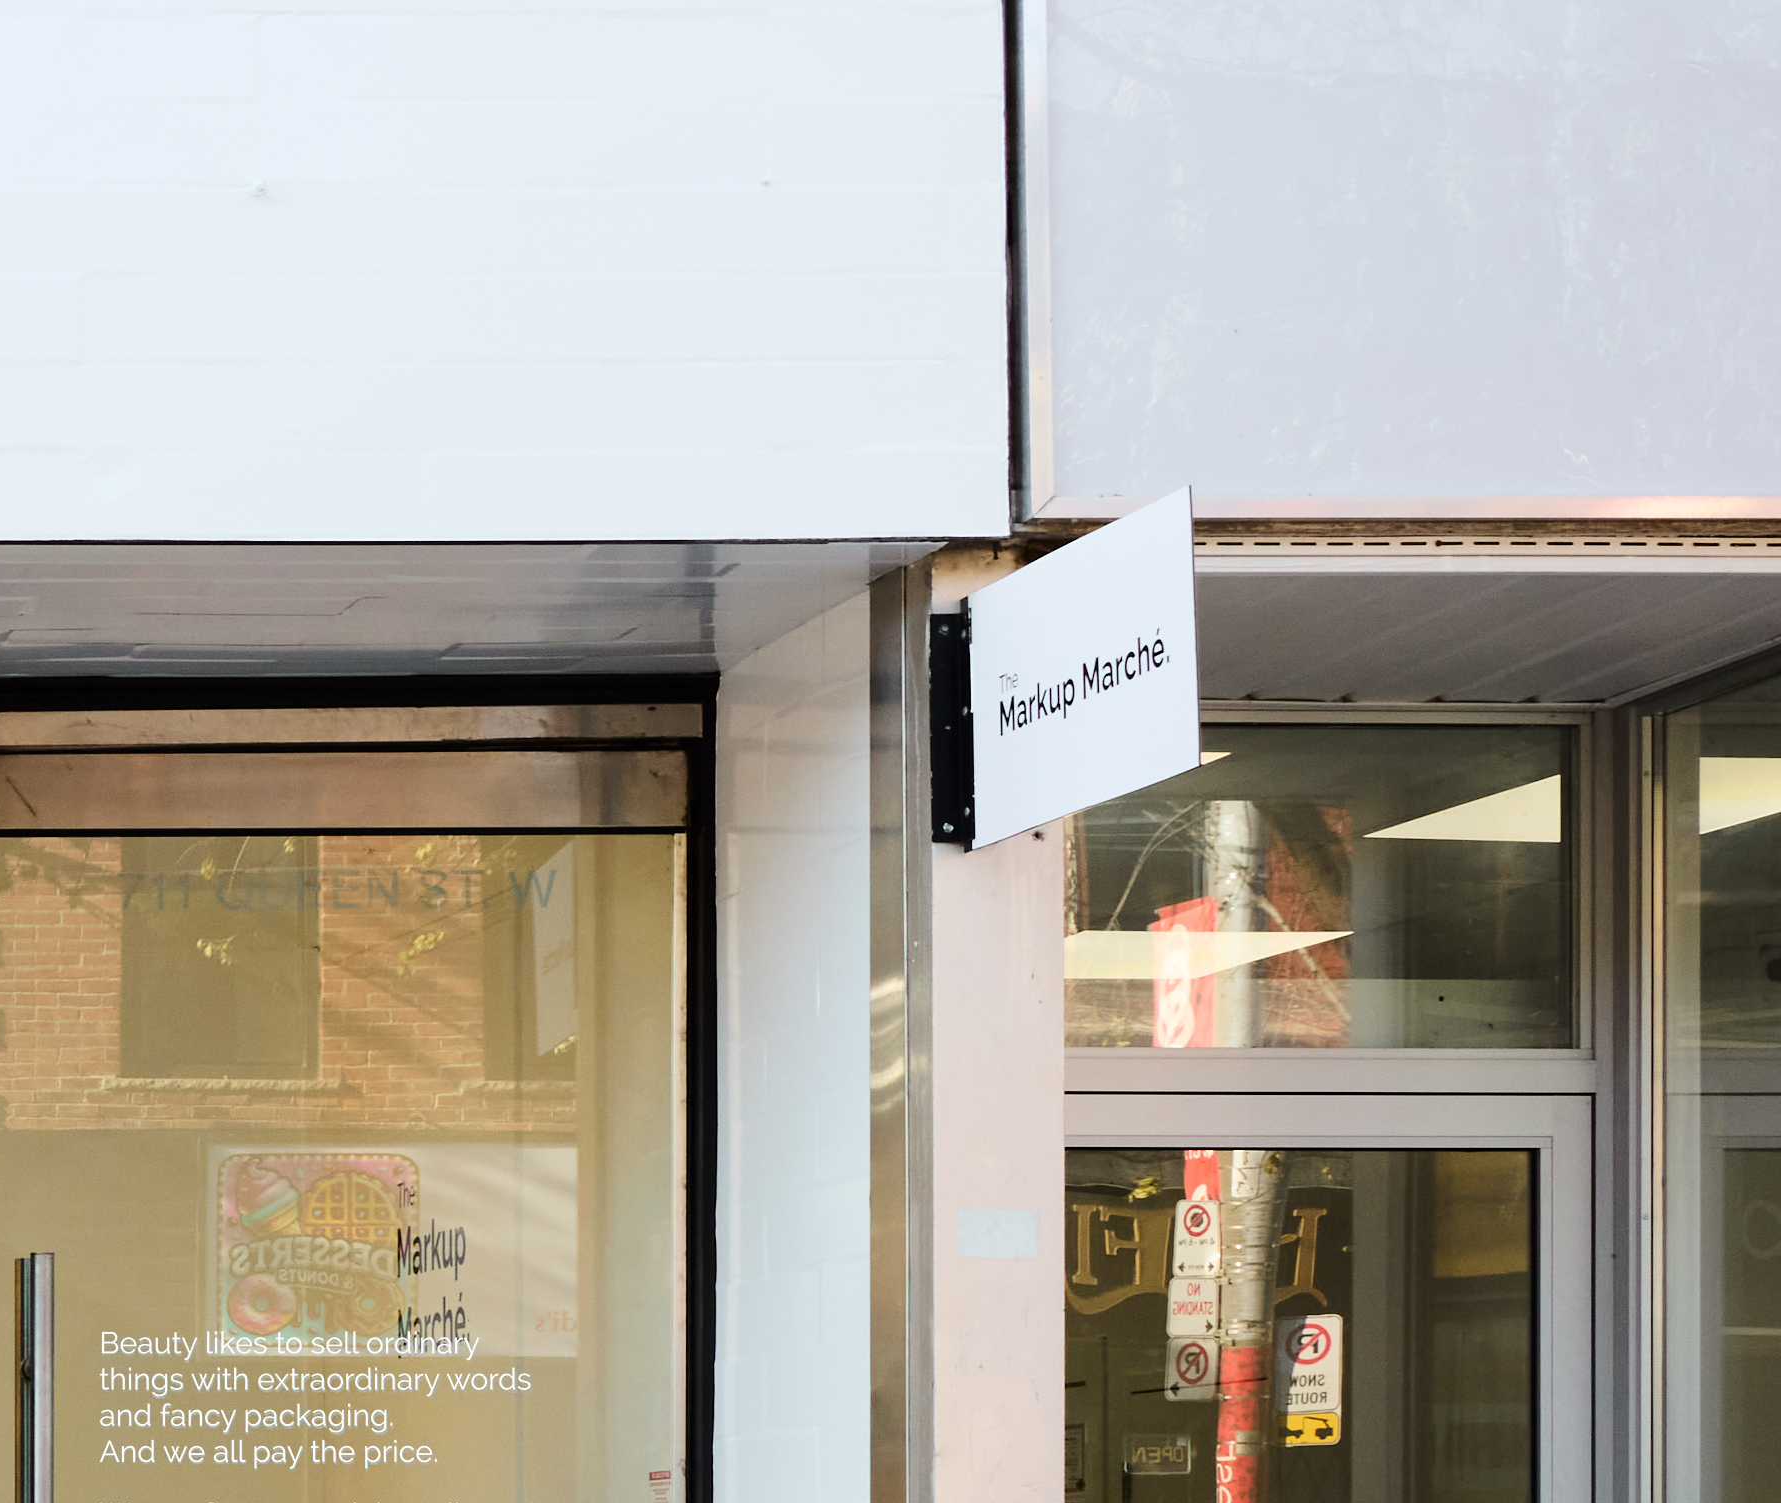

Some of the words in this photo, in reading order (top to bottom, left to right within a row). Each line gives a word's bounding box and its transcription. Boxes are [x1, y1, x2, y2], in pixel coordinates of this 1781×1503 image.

[999, 671, 1019, 694] The
[999, 678, 1075, 737] Markup
[1082, 628, 1170, 700] Marché.
[508, 870, 556, 908] W
[397, 1182, 417, 1208] The
[397, 1219, 467, 1280] Markup
[101, 1331, 198, 1361] Beauty
[206, 1330, 267, 1355] likes
[275, 1331, 303, 1355] to
[311, 1331, 360, 1355] sell
[366, 1331, 480, 1361] ordinary
[99, 1367, 184, 1397] things
[191, 1367, 248, 1391] with
[258, 1367, 440, 1397] extraordinary
[446, 1367, 531, 1391] words
[99, 1403, 151, 1427] and
[160, 1403, 237, 1433] fancy
[245, 1403, 393, 1433] packaging.
